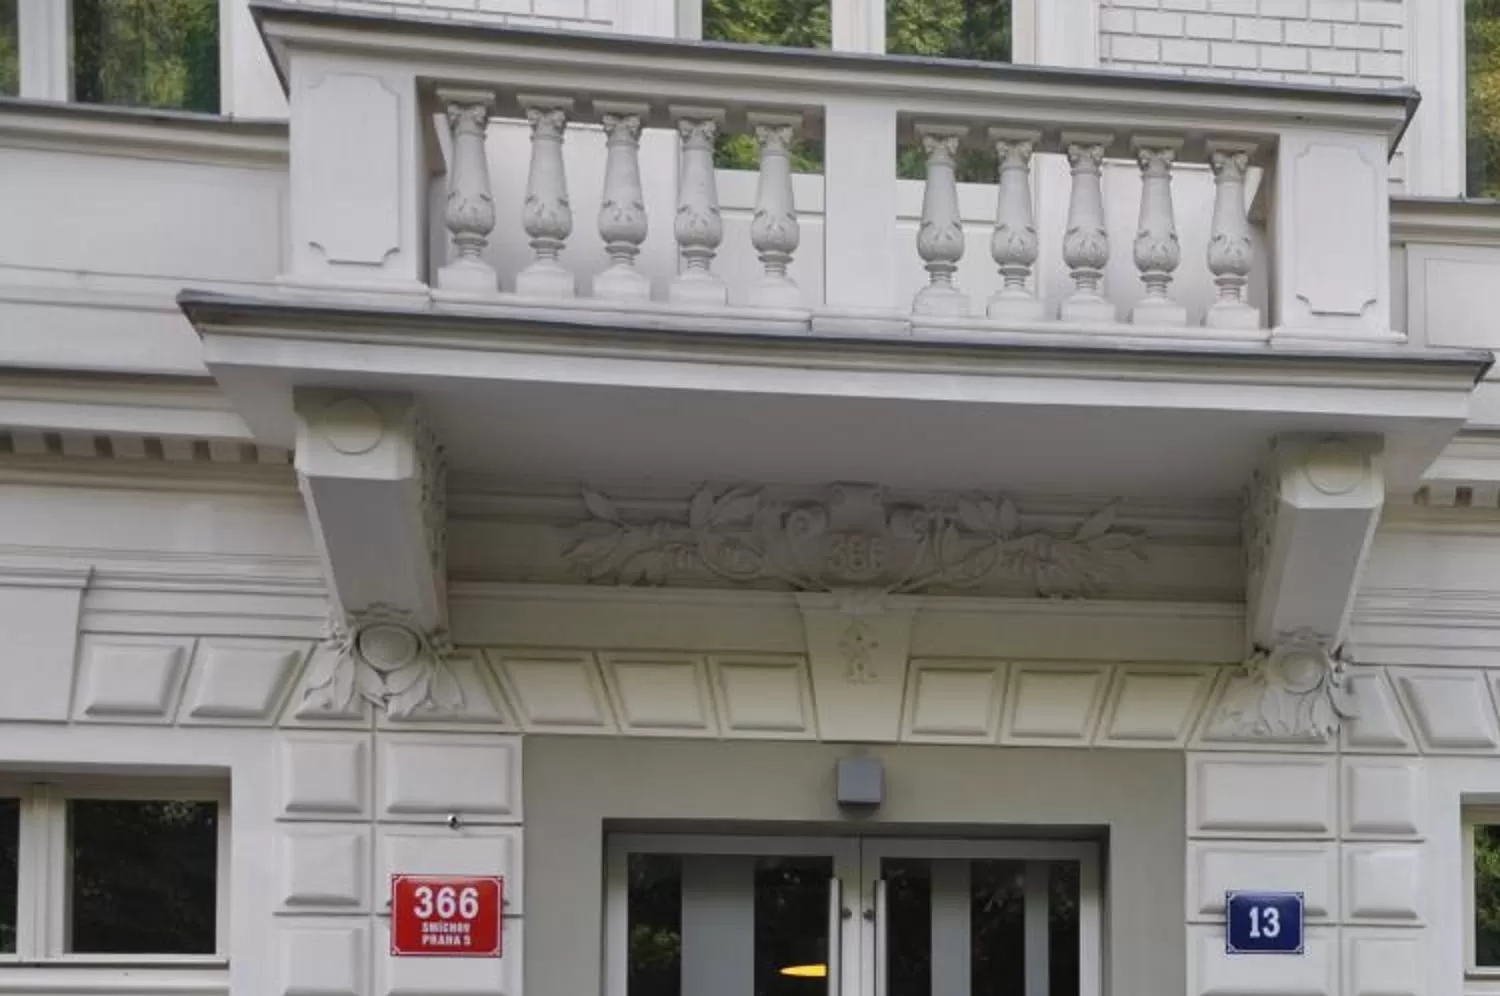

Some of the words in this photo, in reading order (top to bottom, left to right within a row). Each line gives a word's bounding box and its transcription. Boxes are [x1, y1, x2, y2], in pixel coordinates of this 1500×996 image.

[413, 886, 479, 919] 366
[1249, 906, 1281, 938] 13
[422, 934, 461, 945] PRAHA
